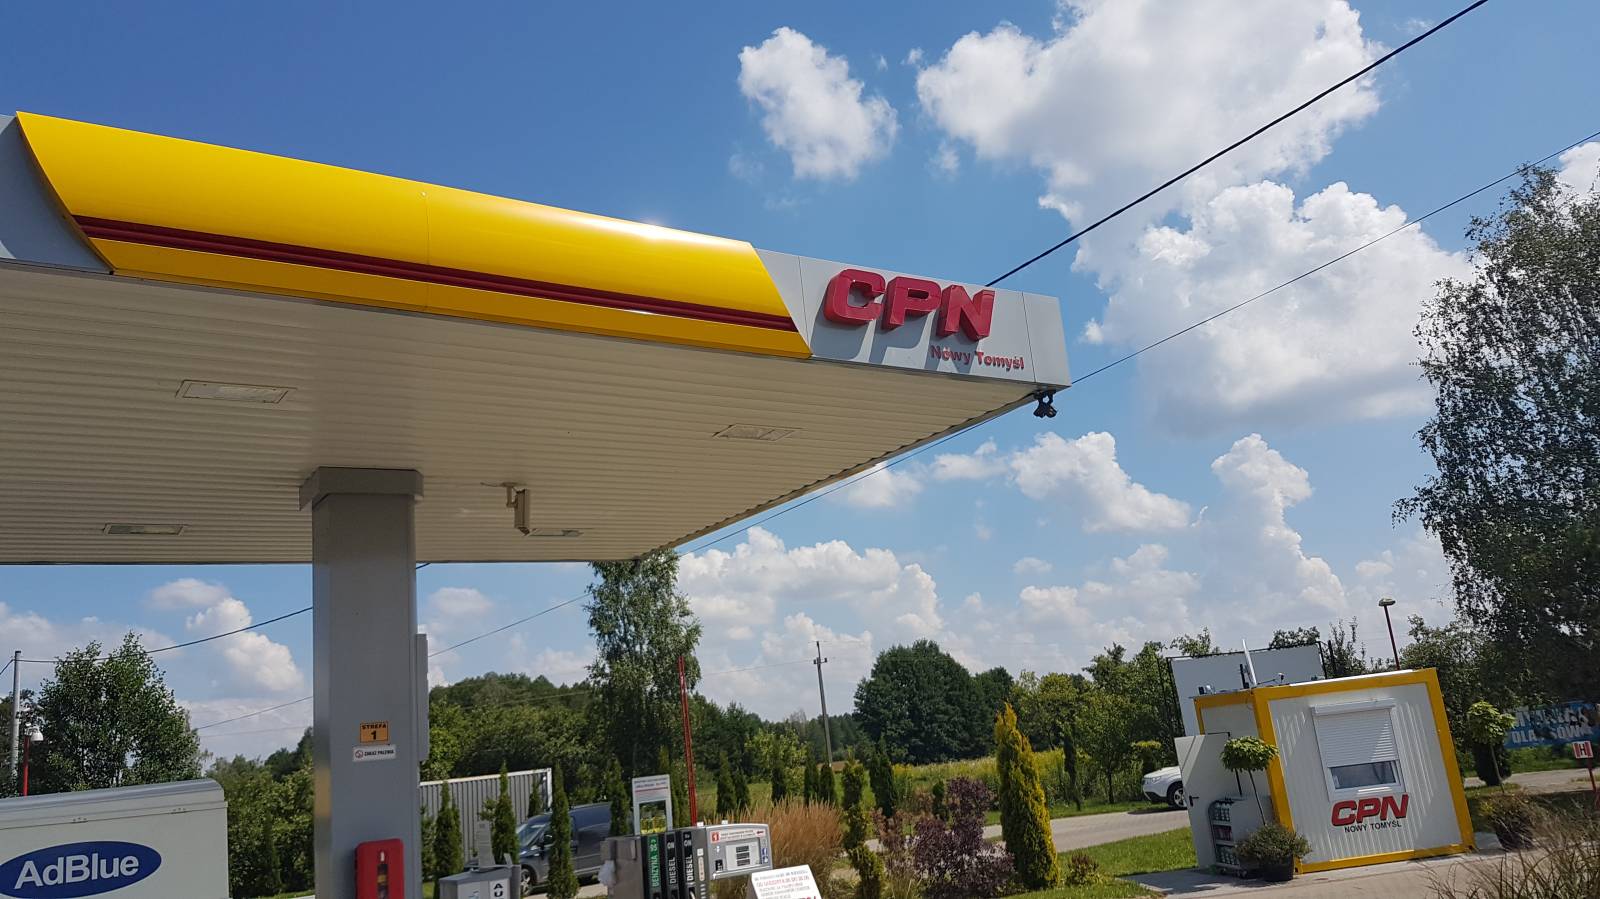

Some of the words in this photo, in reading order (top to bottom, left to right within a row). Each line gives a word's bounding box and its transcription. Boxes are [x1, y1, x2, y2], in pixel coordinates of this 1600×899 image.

[823, 268, 996, 342] CPN
[930, 345, 971, 366] Nowy
[974, 350, 1025, 372] Tomyśl
[370, 730, 377, 740] 1
[1331, 793, 1410, 826] CPN
[1344, 824, 1368, 833] NOWY
[14, 852, 140, 890] AdBlue
[668, 856, 677, 884] DIESEL
[685, 854, 694, 881] DIESEL
